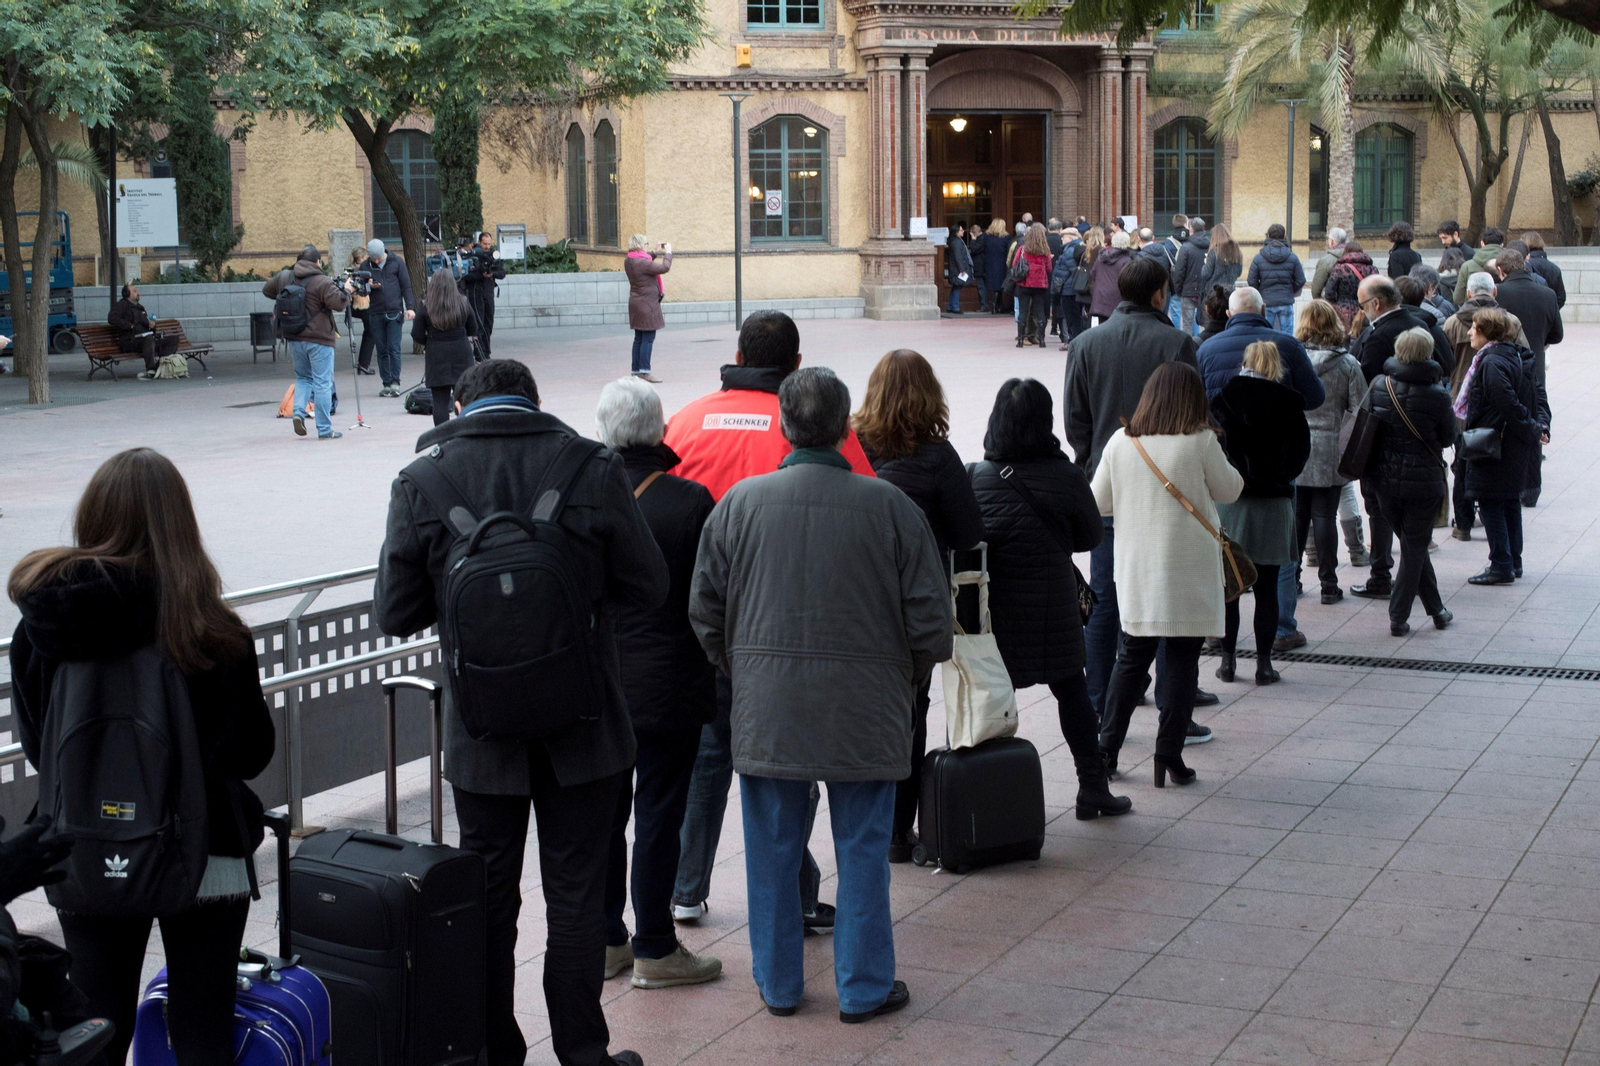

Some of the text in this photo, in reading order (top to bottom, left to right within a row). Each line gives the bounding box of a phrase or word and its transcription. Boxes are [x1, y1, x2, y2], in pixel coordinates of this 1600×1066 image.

[904, 28, 979, 41] ESCOLA
[997, 29, 1034, 41] DEL
[723, 418, 769, 427] SCHENKER
[104, 870, 128, 878] adidas
